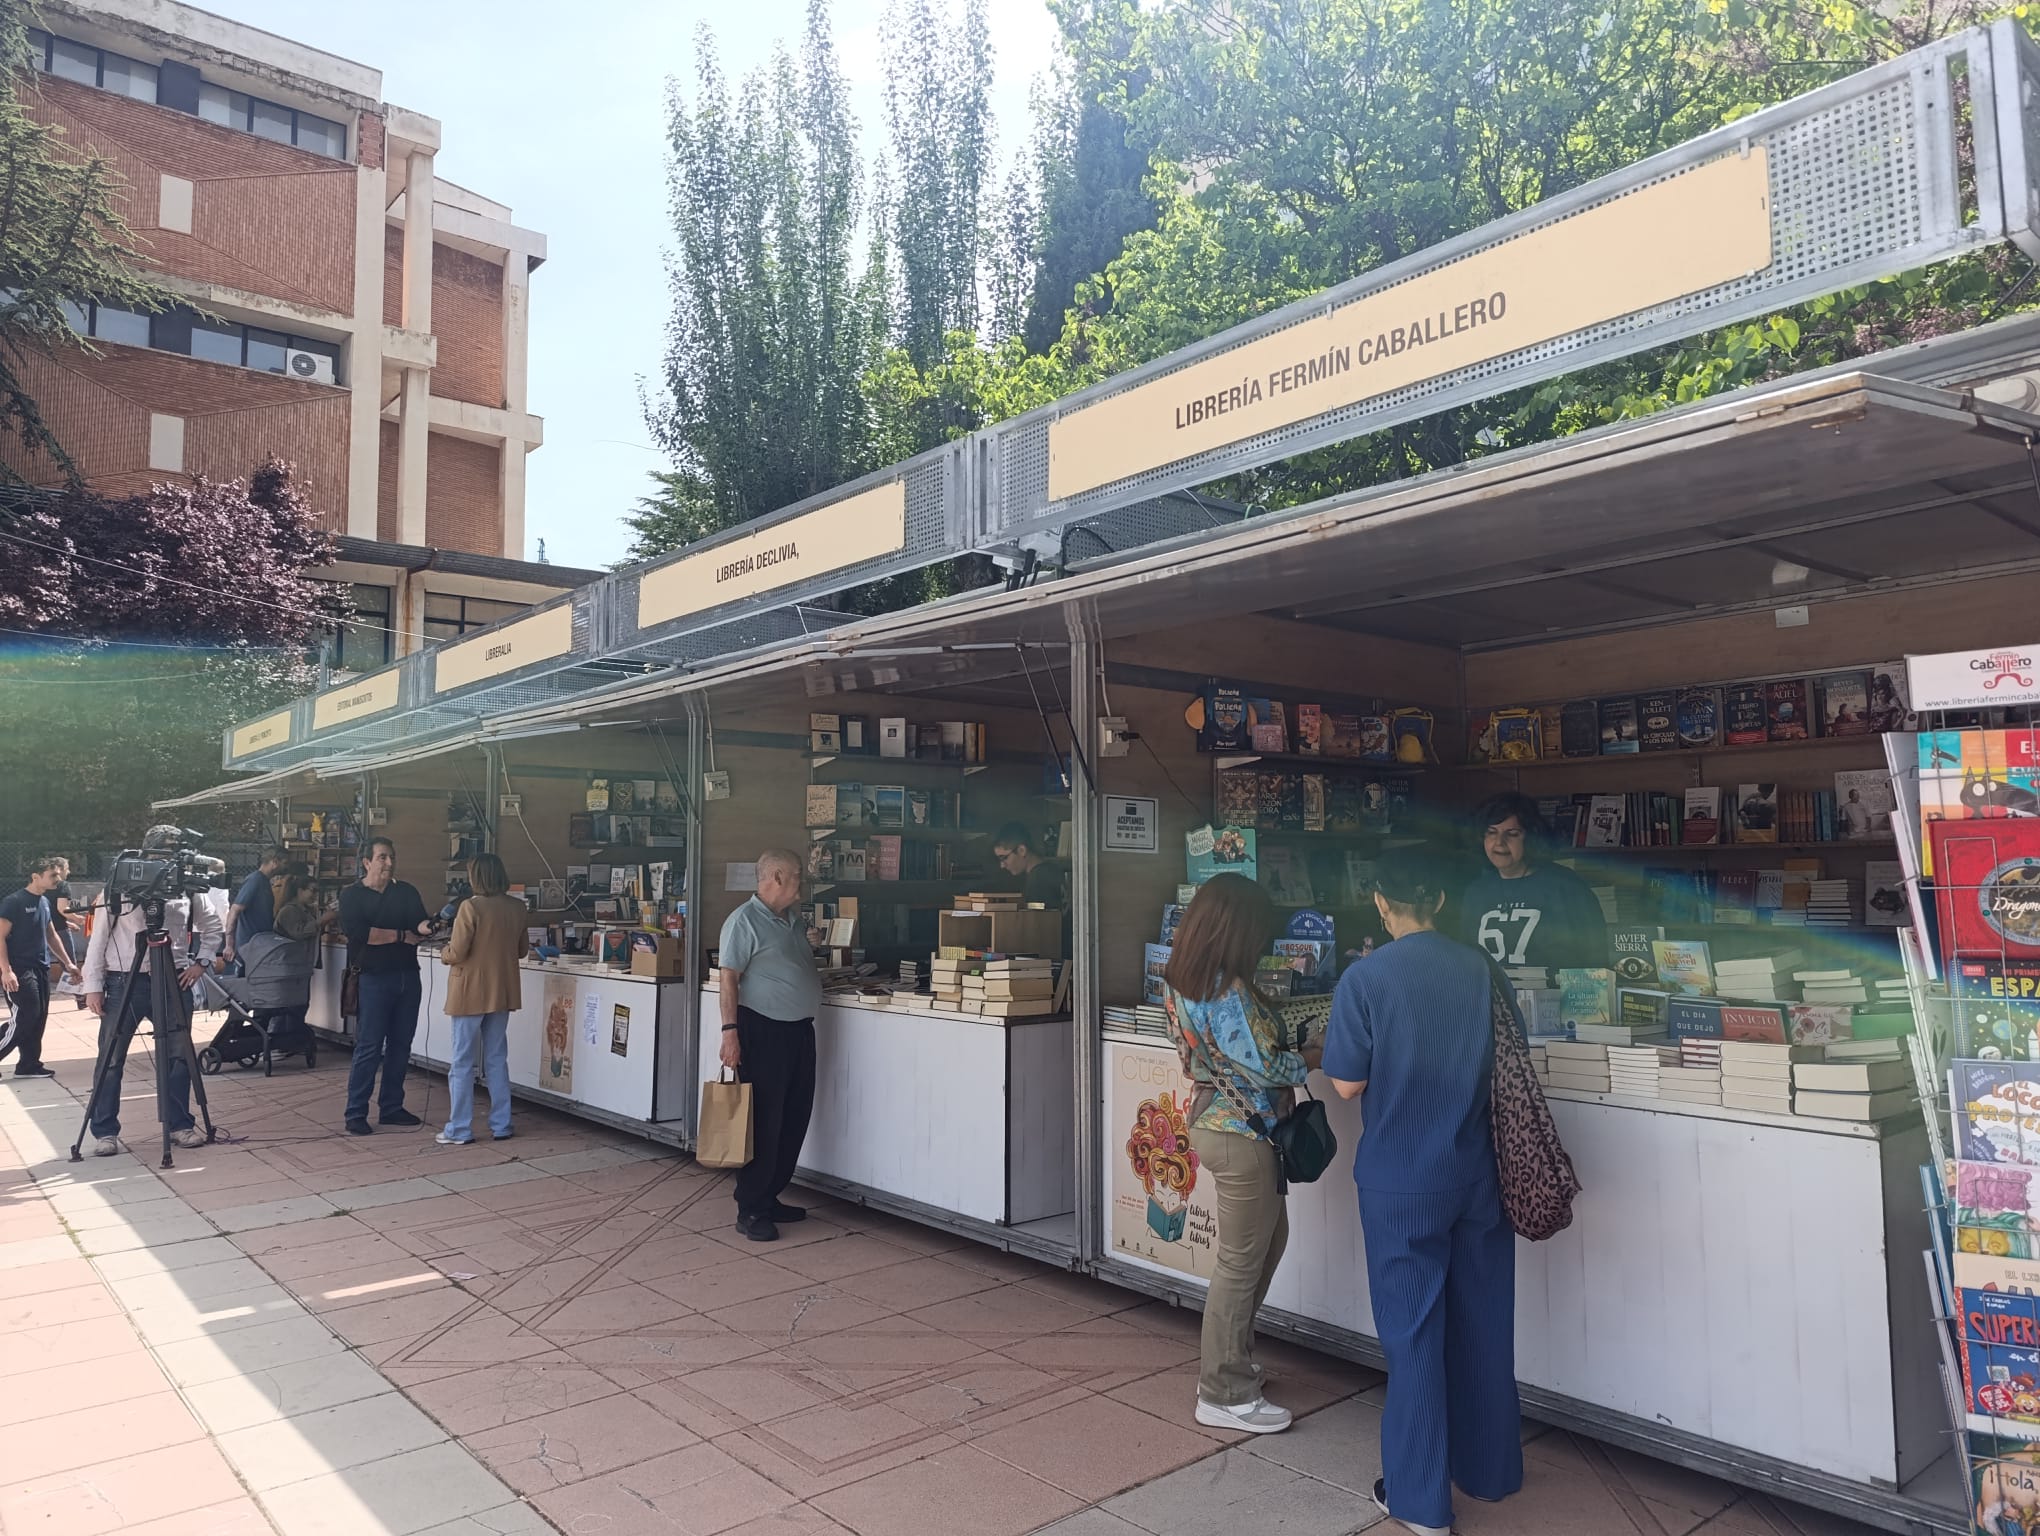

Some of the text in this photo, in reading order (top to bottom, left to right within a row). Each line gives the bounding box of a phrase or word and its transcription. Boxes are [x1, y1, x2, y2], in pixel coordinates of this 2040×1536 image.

[1175, 291, 1507, 430] LIBRERÍA FERMÍN CABALLERO
[716, 555, 754, 584] LIBRERÍA
[1970, 657, 2032, 673] Caballero
[1649, 699, 1665, 707] KEN
[1924, 691, 2040, 707] www.libreriafermincaba
[1642, 704, 1673, 715] FOLLETT
[1117, 815, 1145, 825] ACEPTAMOS
[1478, 908, 1542, 965] 67
[1614, 933, 1648, 944] JAVIER
[1286, 943, 1313, 951] BOSQUE
[1615, 943, 1649, 953] SIERRA
[1681, 1010, 1692, 1019] EL
[1723, 1012, 1778, 1027] INVICTO
[1676, 1023, 1691, 1033] QUE
[1189, 1220, 1216, 1238] muchos
[1189, 1231, 1210, 1250] libros
[1969, 1311, 2040, 1345] SUPER
